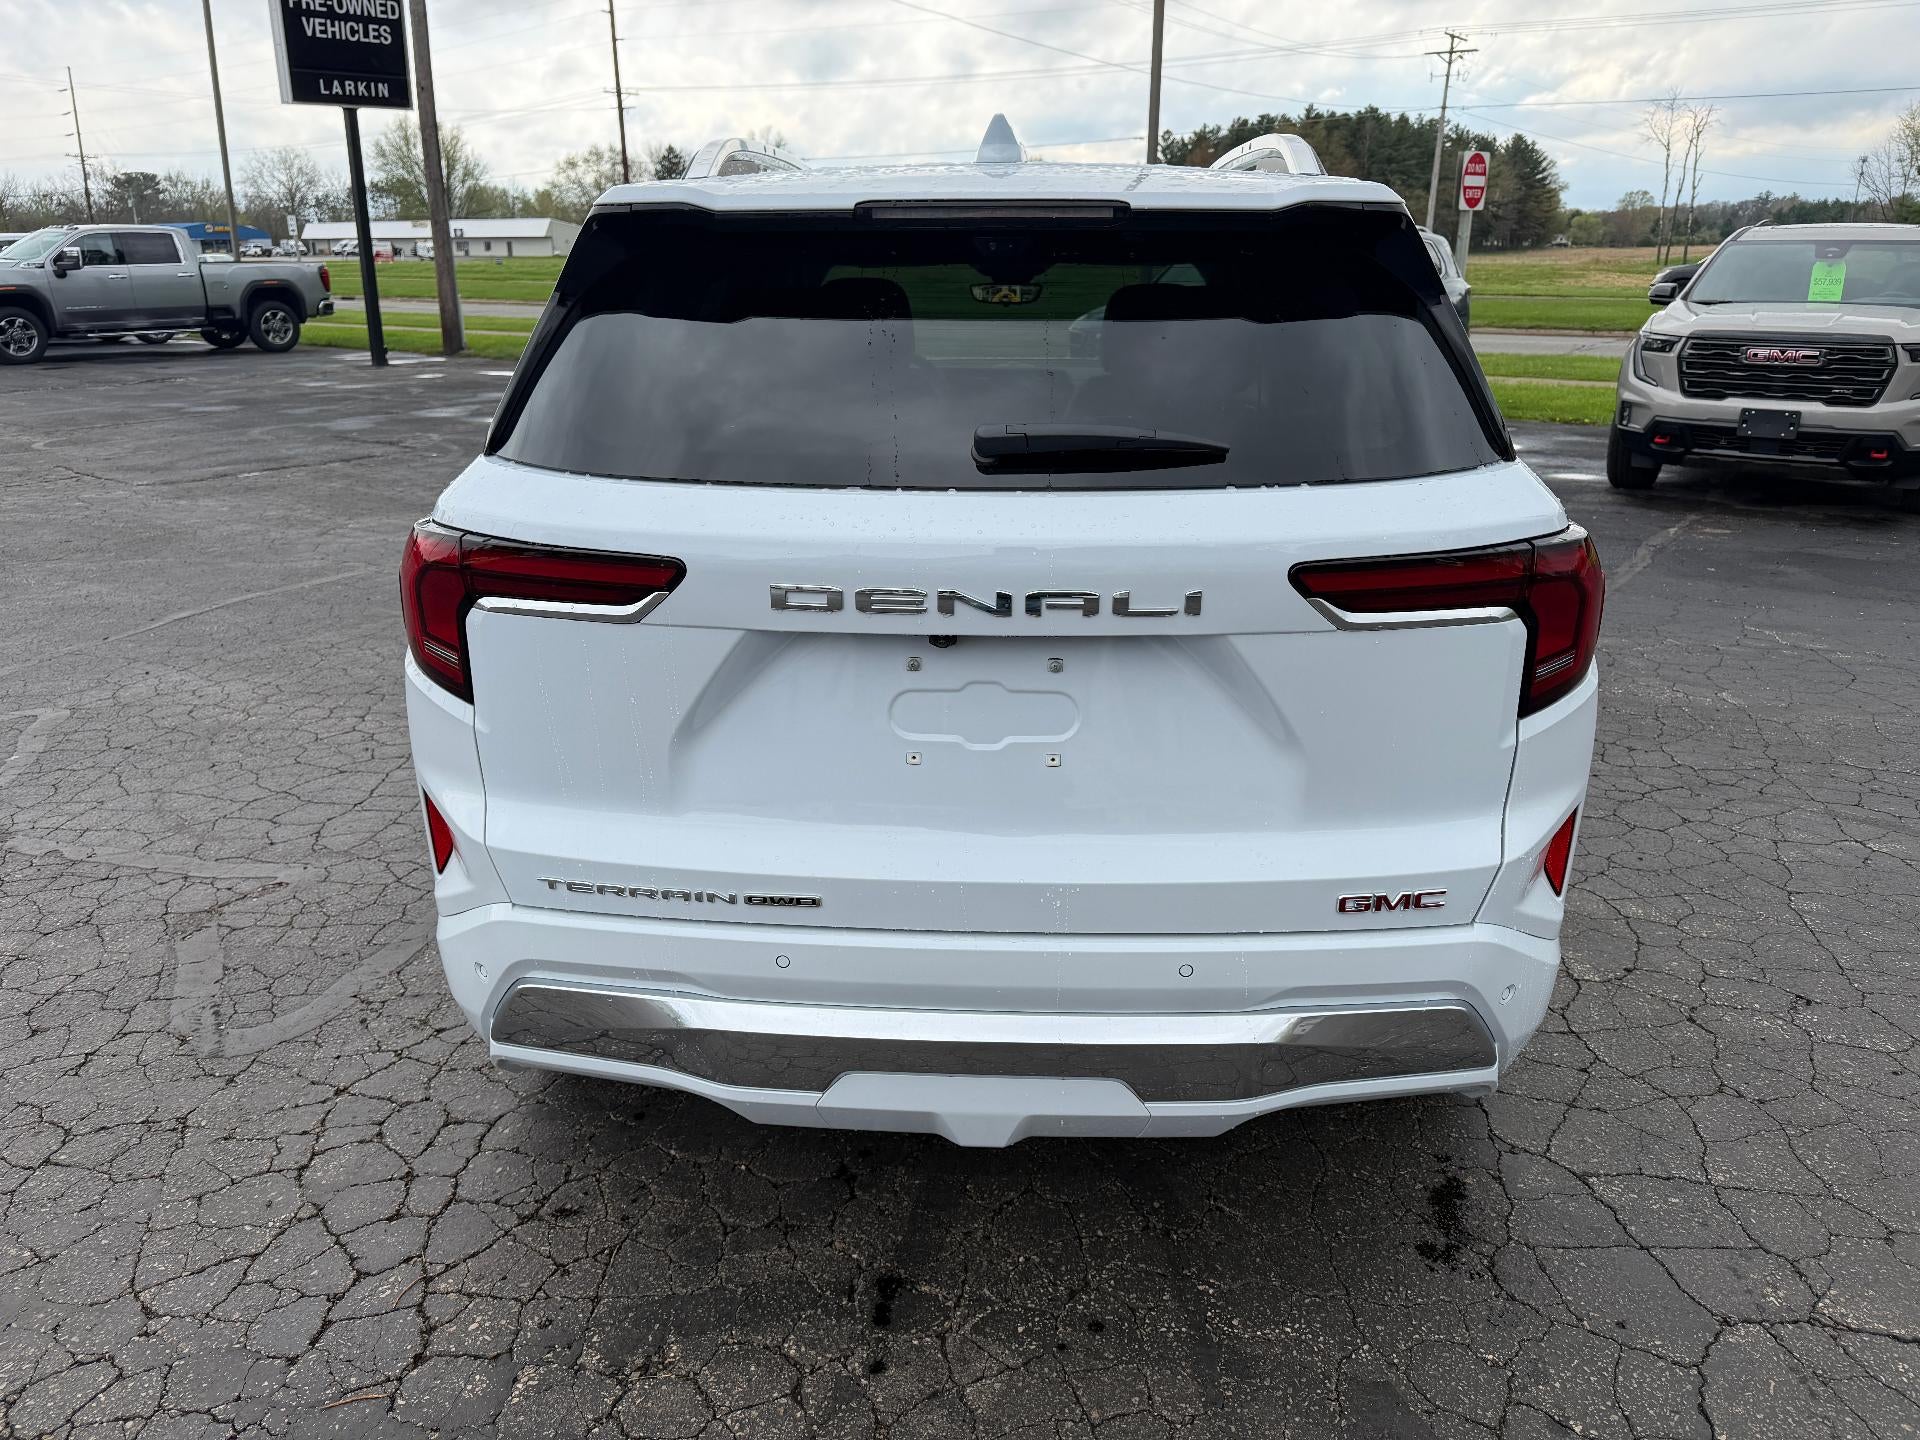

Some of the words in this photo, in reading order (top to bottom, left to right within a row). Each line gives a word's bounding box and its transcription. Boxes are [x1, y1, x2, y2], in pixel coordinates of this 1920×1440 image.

[301, 16, 392, 45] VEHICLES
[319, 78, 389, 98] LARKIN
[1467, 163, 1475, 173] DO
[1475, 163, 1486, 174] NOT
[1465, 188, 1482, 199] ENTER
[1746, 348, 1820, 364] GMC
[769, 583, 1203, 617] DENALI
[536, 876, 738, 905] TERRAIN
[743, 893, 822, 908] AWD
[1337, 888, 1448, 913] GMC
